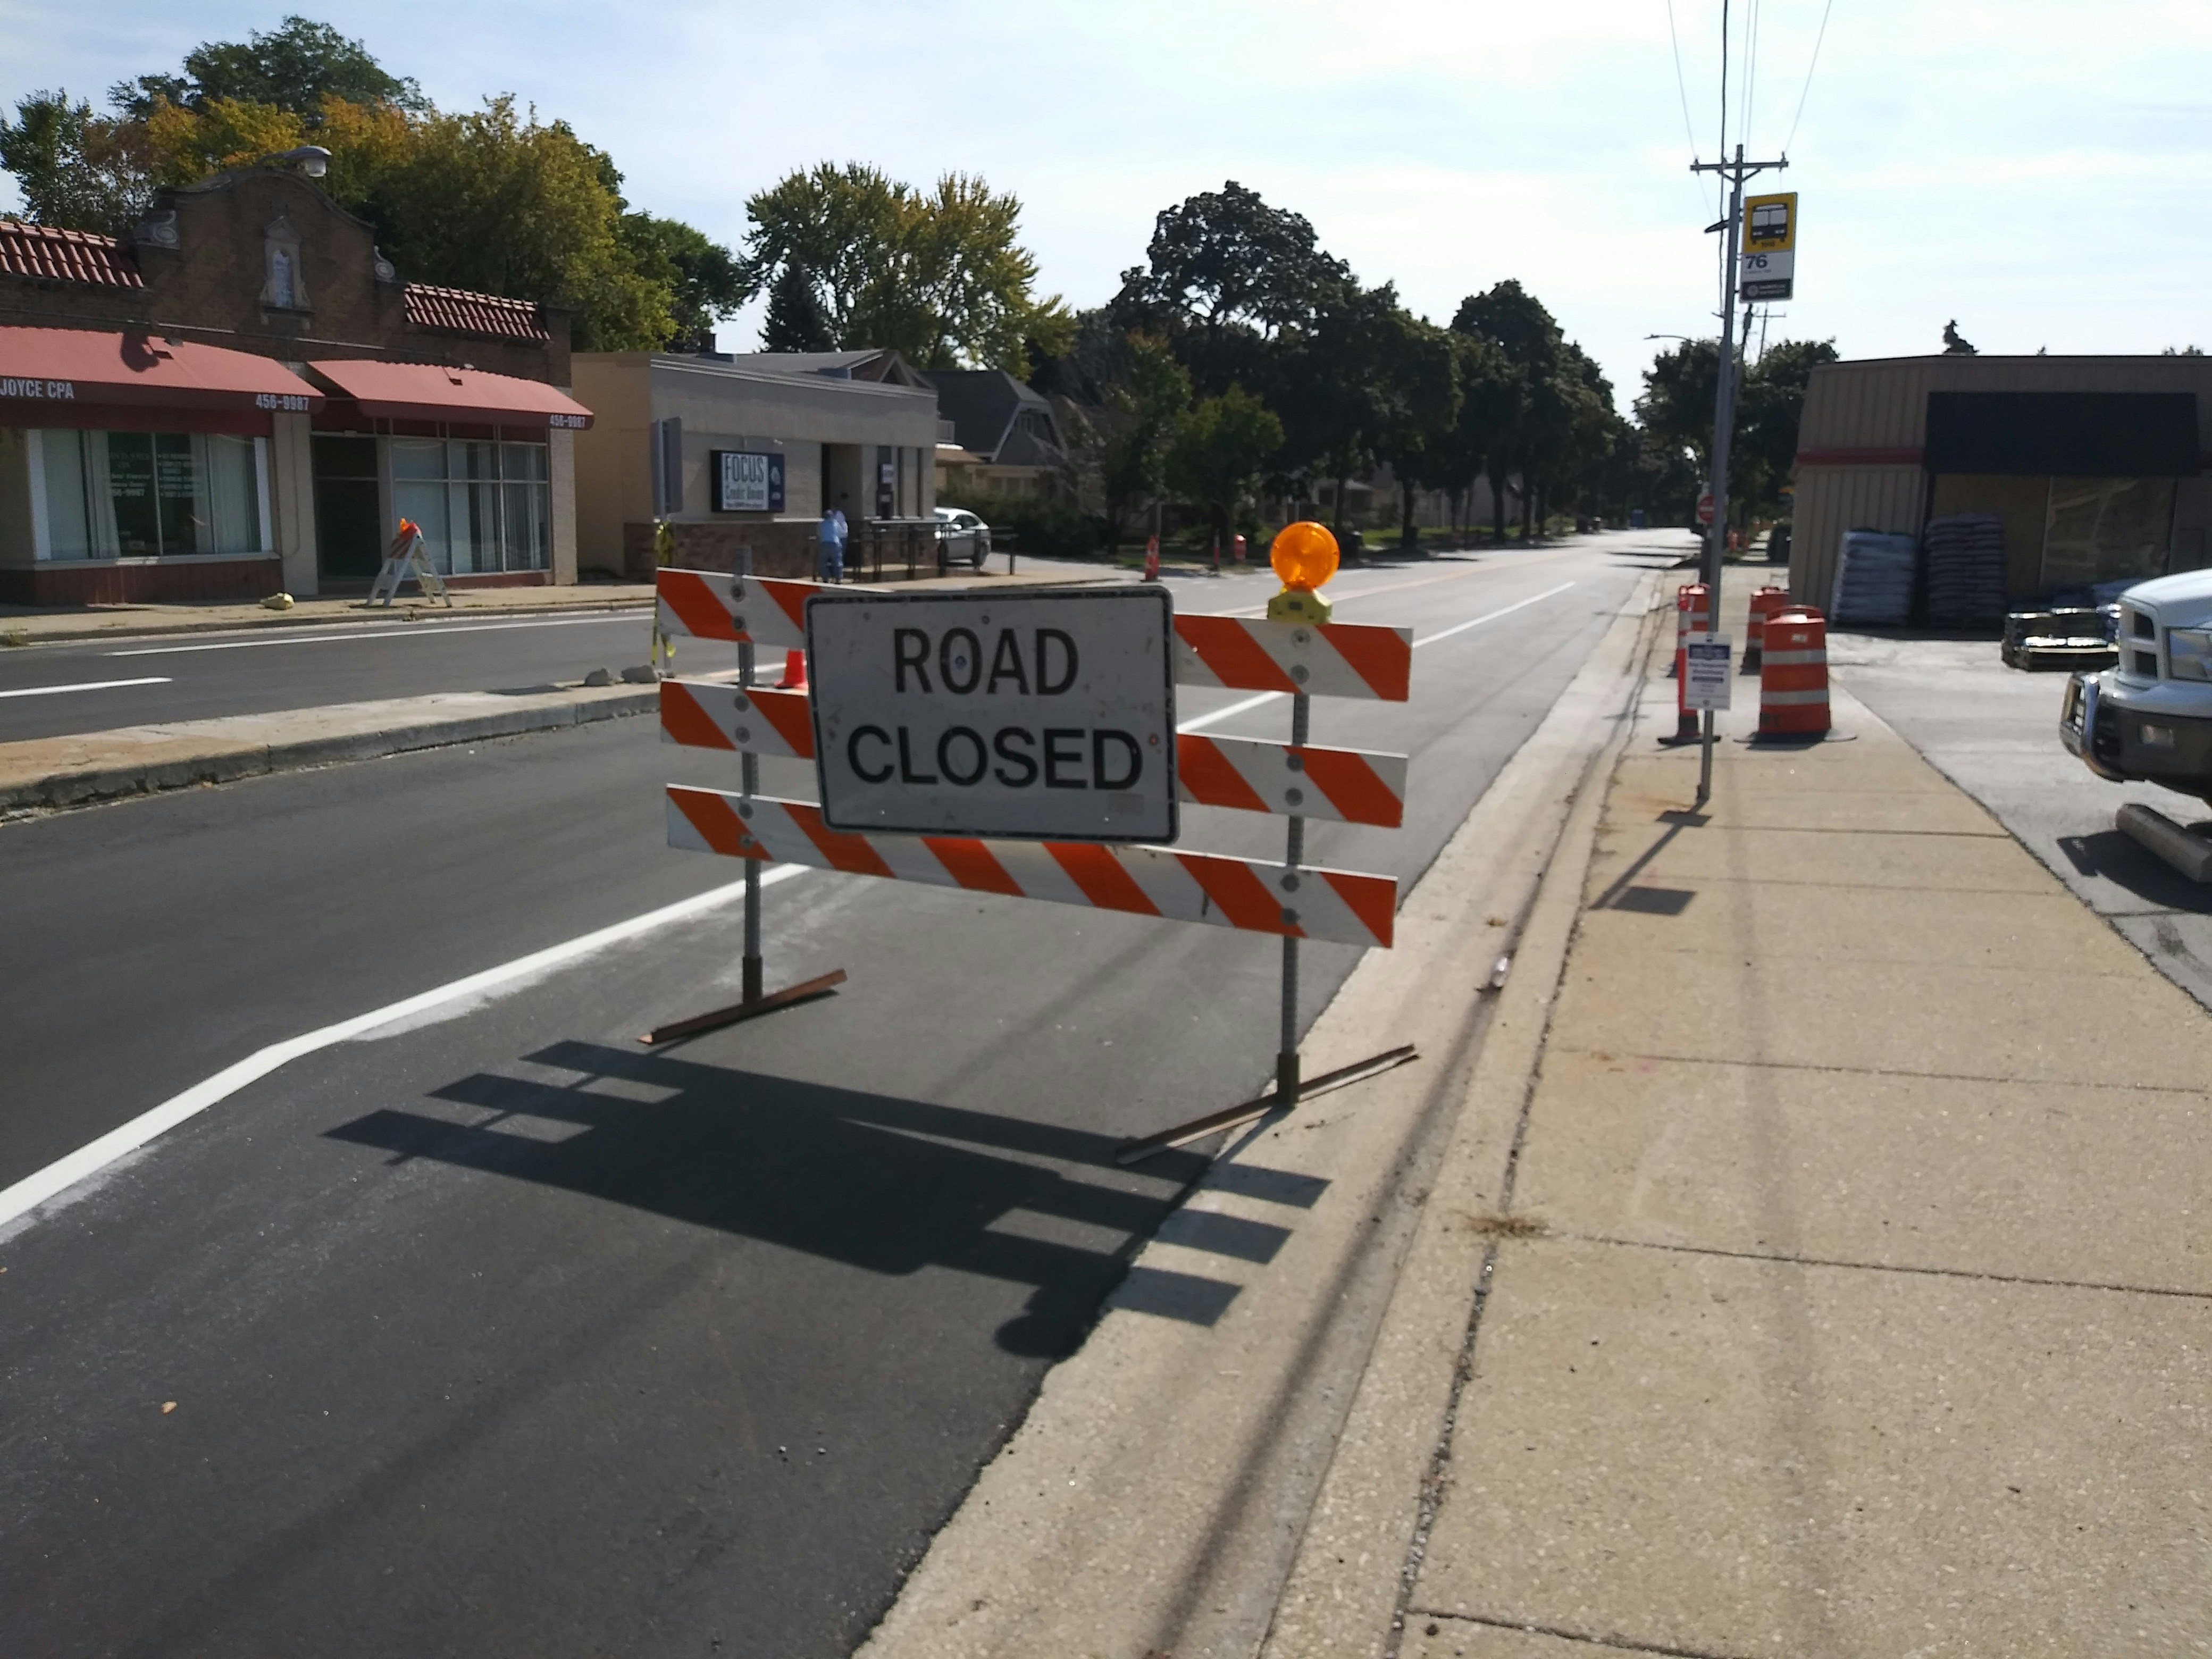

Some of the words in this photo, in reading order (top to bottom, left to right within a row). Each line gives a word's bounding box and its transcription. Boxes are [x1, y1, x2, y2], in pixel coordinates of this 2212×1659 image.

[1746, 255, 1767, 269] 76
[0, 379, 43, 397] JOYCE
[47, 381, 74, 399] CPA
[725, 456, 764, 482] FOCUS
[893, 627, 1079, 696] ROAD
[848, 724, 1144, 791] CLOSED
